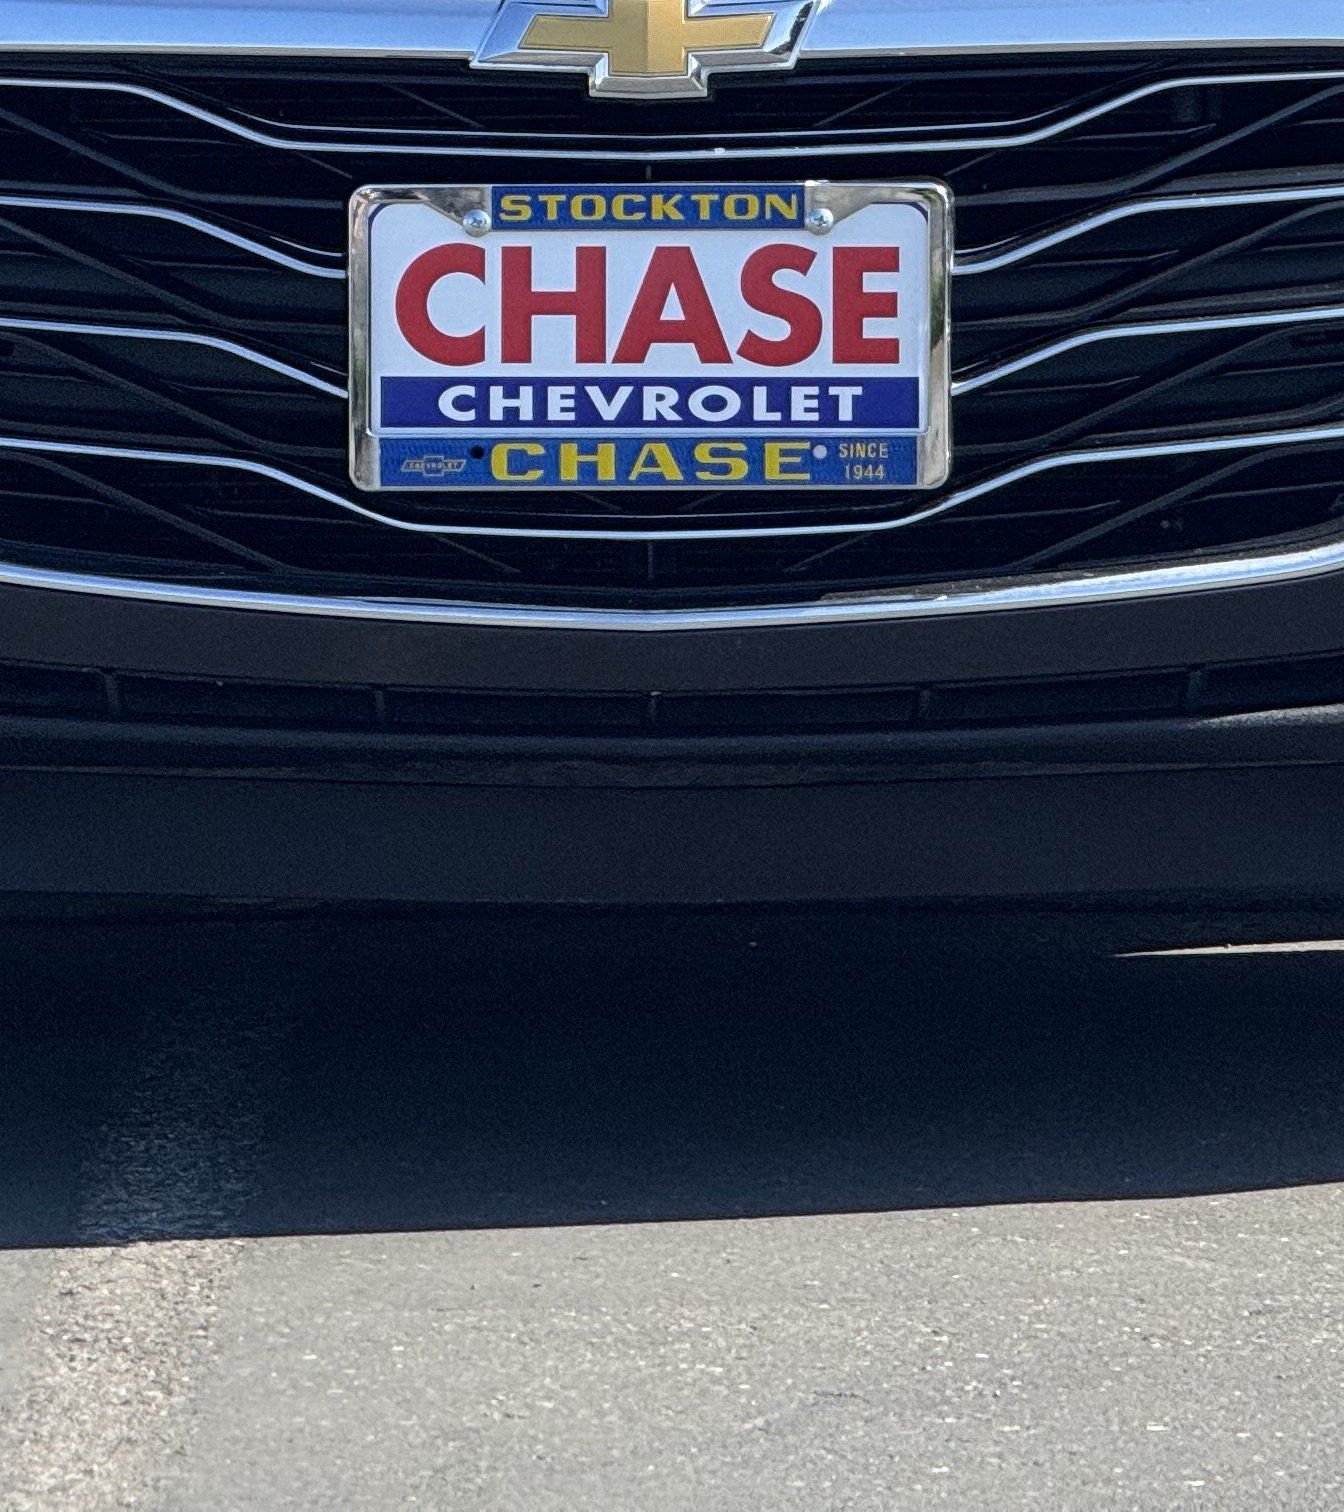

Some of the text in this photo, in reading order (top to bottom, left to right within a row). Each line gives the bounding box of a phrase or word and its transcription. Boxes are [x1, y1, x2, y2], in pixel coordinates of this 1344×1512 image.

[498, 192, 799, 222] STOCKTON
[395, 242, 900, 367] CHASE
[437, 384, 864, 422] CHEVROLET
[490, 441, 814, 482] CHASE
[839, 442, 889, 459] SINCE
[844, 464, 886, 480] 1944
